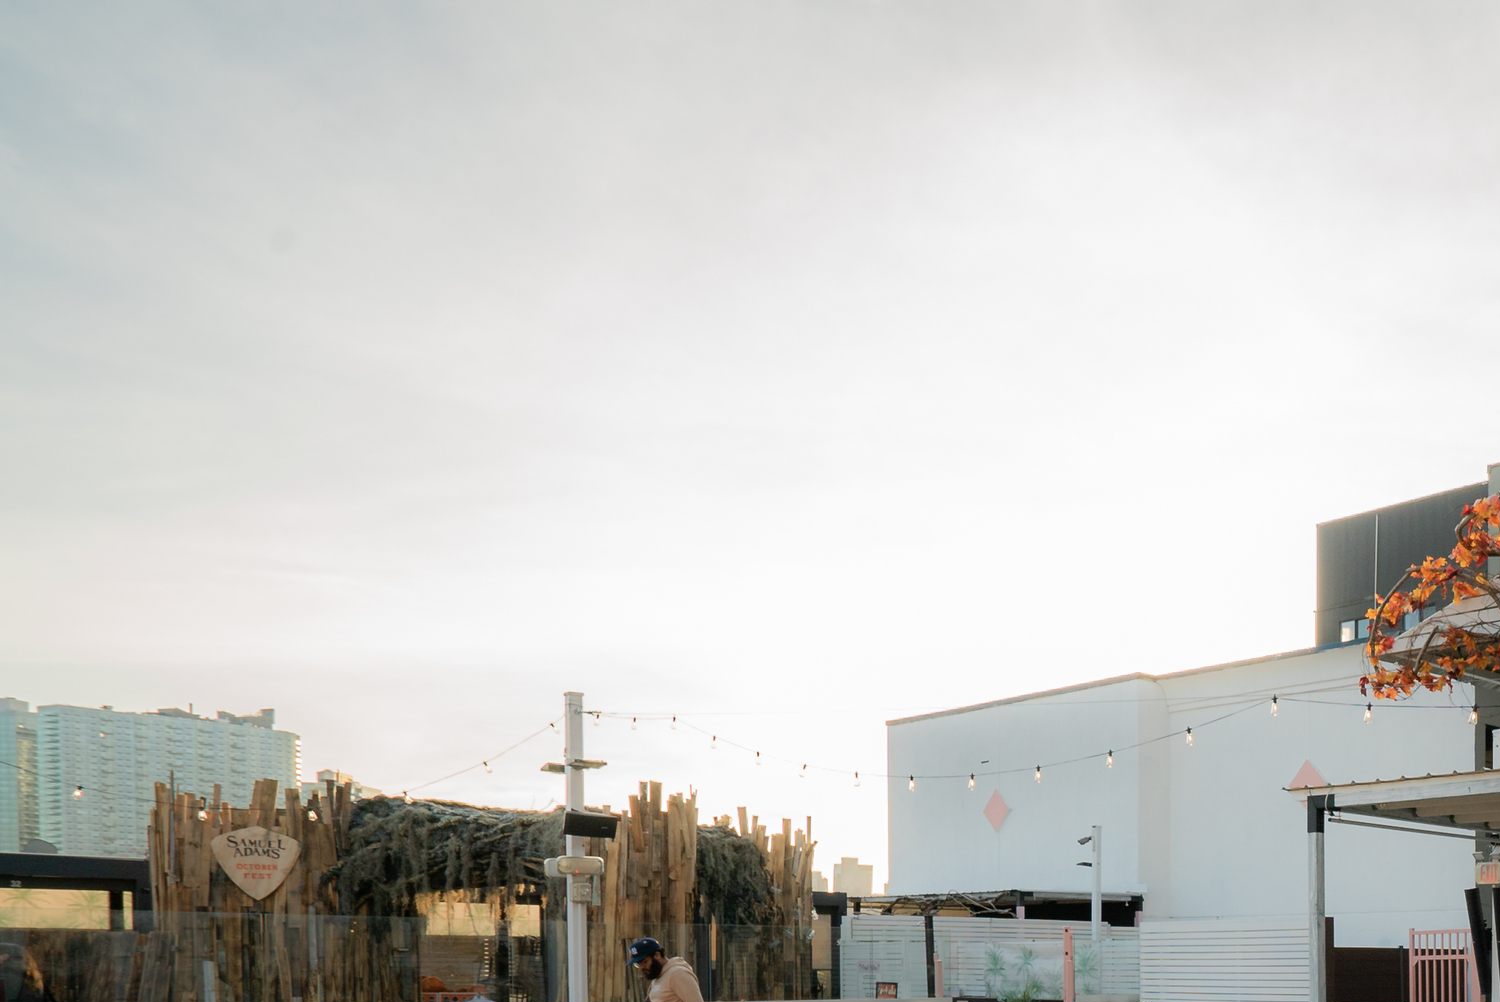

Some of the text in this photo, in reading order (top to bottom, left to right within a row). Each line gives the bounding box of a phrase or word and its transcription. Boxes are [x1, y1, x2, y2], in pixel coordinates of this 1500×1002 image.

[226, 835, 286, 850] SAMUEL
[233, 847, 281, 859] ADAMS
[1480, 863, 1498, 882] EXIT
